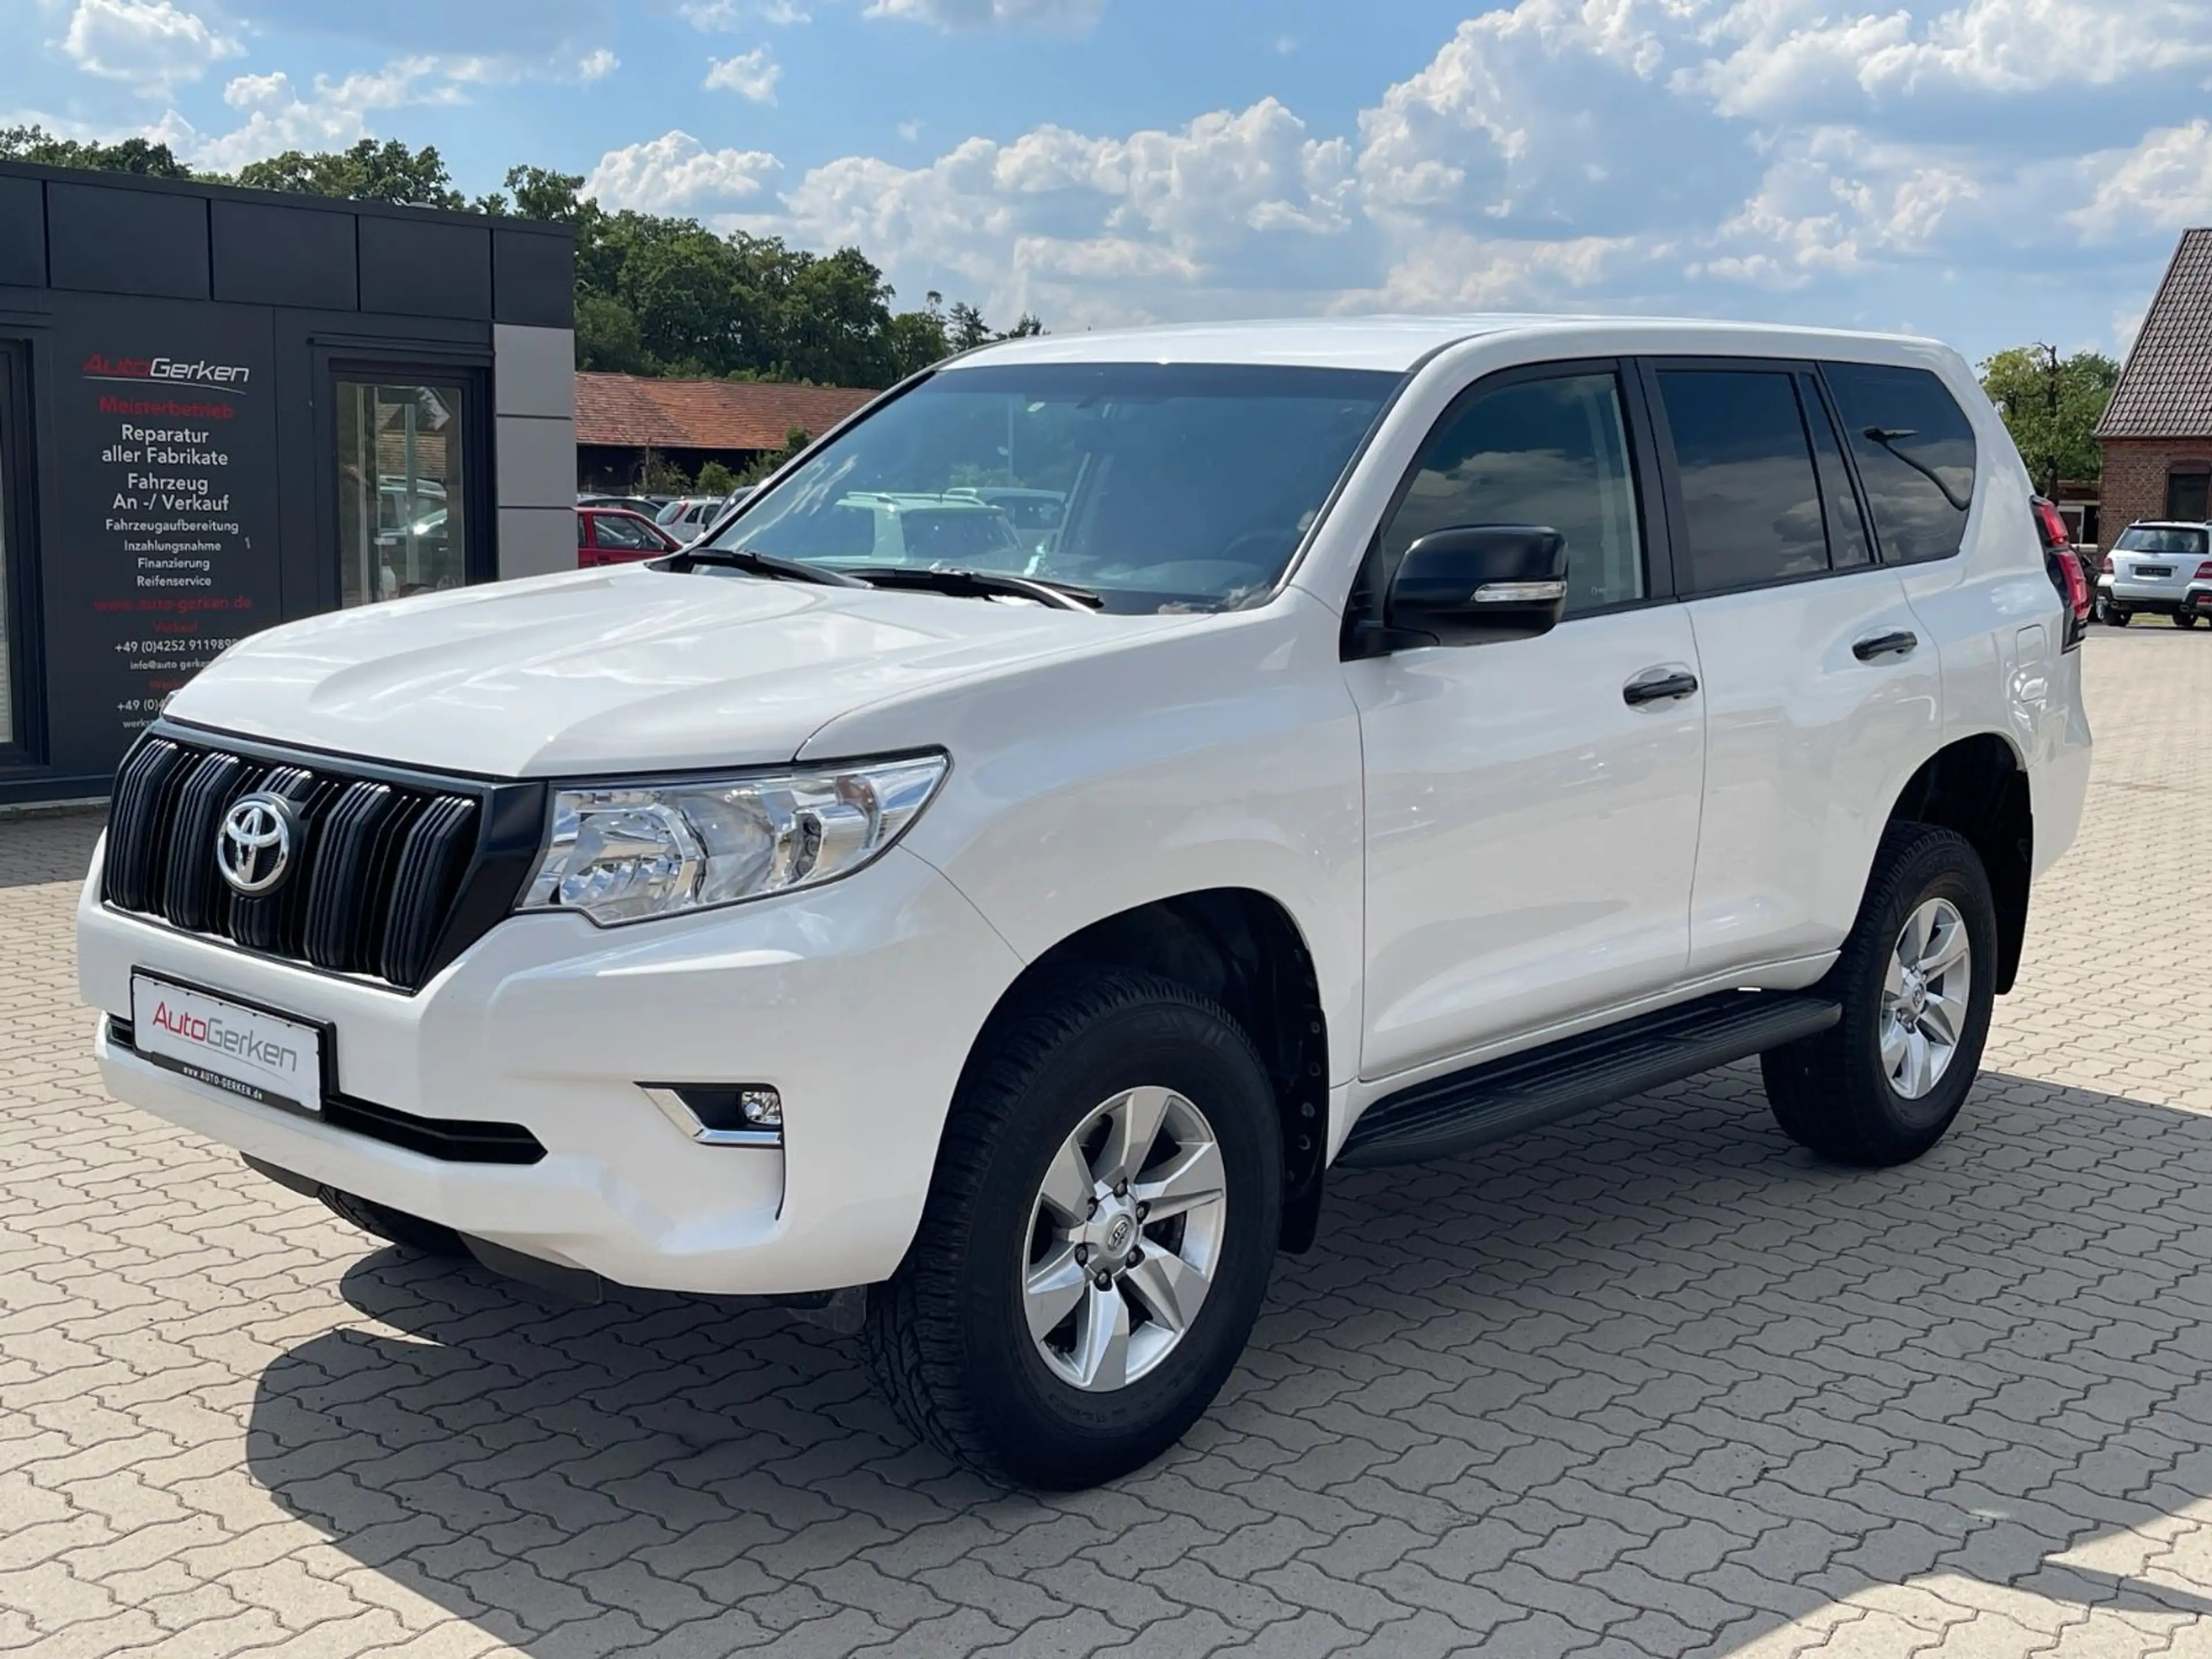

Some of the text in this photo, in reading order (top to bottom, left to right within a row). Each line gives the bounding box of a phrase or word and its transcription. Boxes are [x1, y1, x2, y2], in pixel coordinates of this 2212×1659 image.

[83, 353, 249, 382] AutoGerken
[99, 397, 233, 419] Meisterbetrieb
[122, 424, 209, 445] Reparatur
[102, 445, 228, 465] aller Fabrikate
[128, 473, 208, 494] Fahrzeug
[113, 494, 137, 510] An
[162, 494, 229, 511] Verkauf
[106, 518, 238, 535] Fahrzeugaufbereitung
[124, 539, 221, 554] Inzahlungsnahme
[138, 557, 210, 571] Finanzierung
[137, 575, 211, 587] Reifenservice
[115, 641, 137, 653] +49
[142, 640, 185, 653] (0)4252
[117, 699, 140, 711] +49
[153, 1001, 297, 1071] AutoGerken
[183, 1066, 263, 1100] www.AUTO-GERKEN.de
